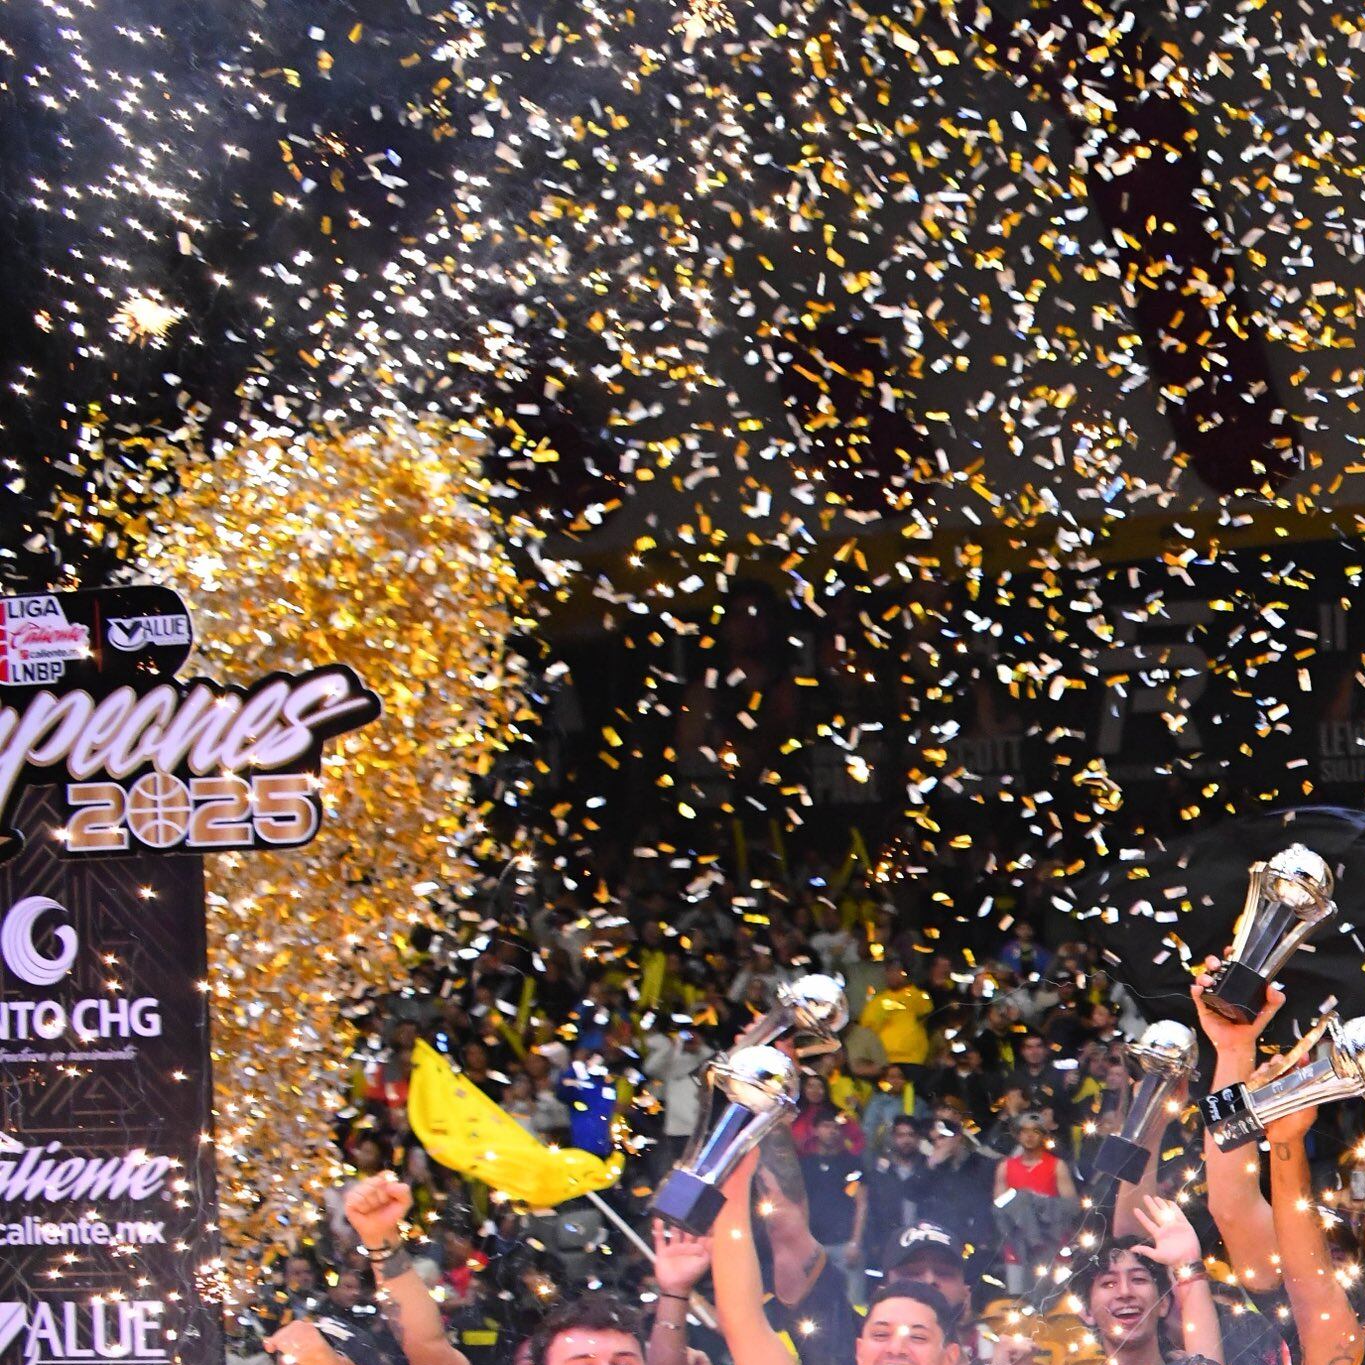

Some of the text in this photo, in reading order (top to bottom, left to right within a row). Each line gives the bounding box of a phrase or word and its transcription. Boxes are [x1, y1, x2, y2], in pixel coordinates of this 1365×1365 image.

[6, 599, 60, 619] LIGA
[11, 661, 64, 683] LNBP
[67, 771, 321, 851] 2025
[72, 997, 162, 1038] CHG
